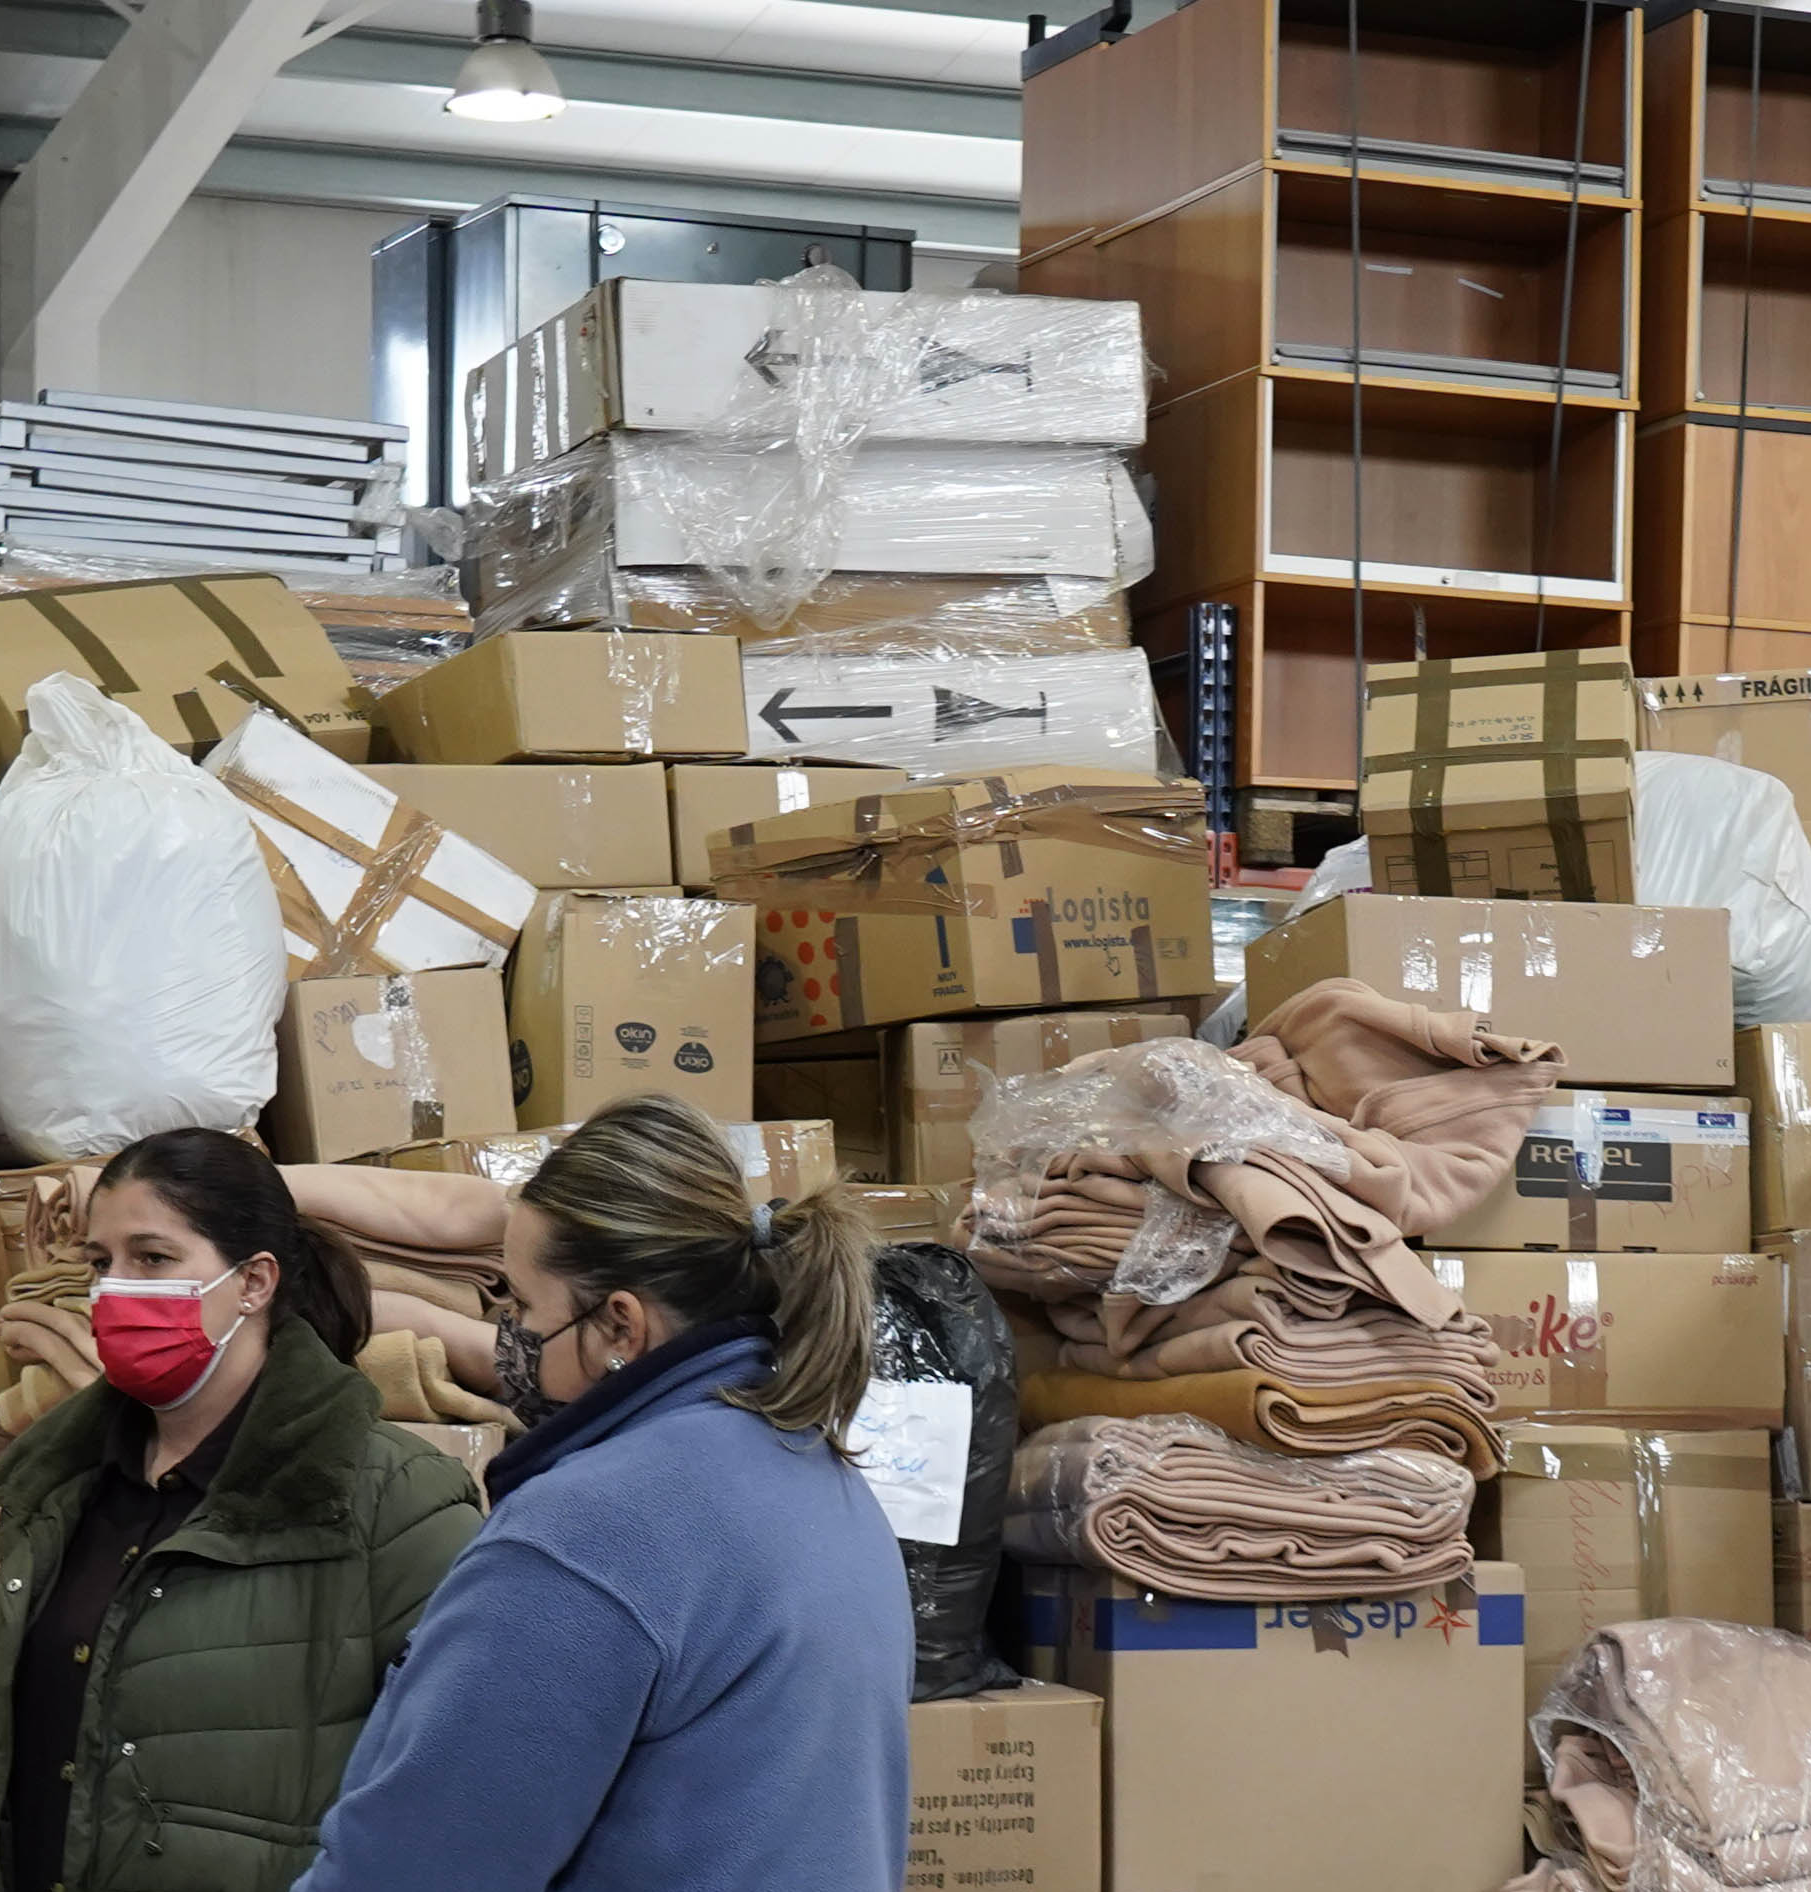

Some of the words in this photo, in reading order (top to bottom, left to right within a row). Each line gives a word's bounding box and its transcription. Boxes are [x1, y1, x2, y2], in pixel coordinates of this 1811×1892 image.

[1045, 886, 1150, 932] Logista
[1063, 934, 1135, 953] www.logista.
[1265, 1597, 1419, 1640] deSer
[985, 1740, 1034, 1757] Carton:
[957, 1768, 992, 1784] date:
[994, 1764, 1034, 1783] Expiry
[913, 1795, 948, 1810] date:
[951, 1791, 1034, 1811] Manufacture
[953, 1868, 1034, 1888] Description:
